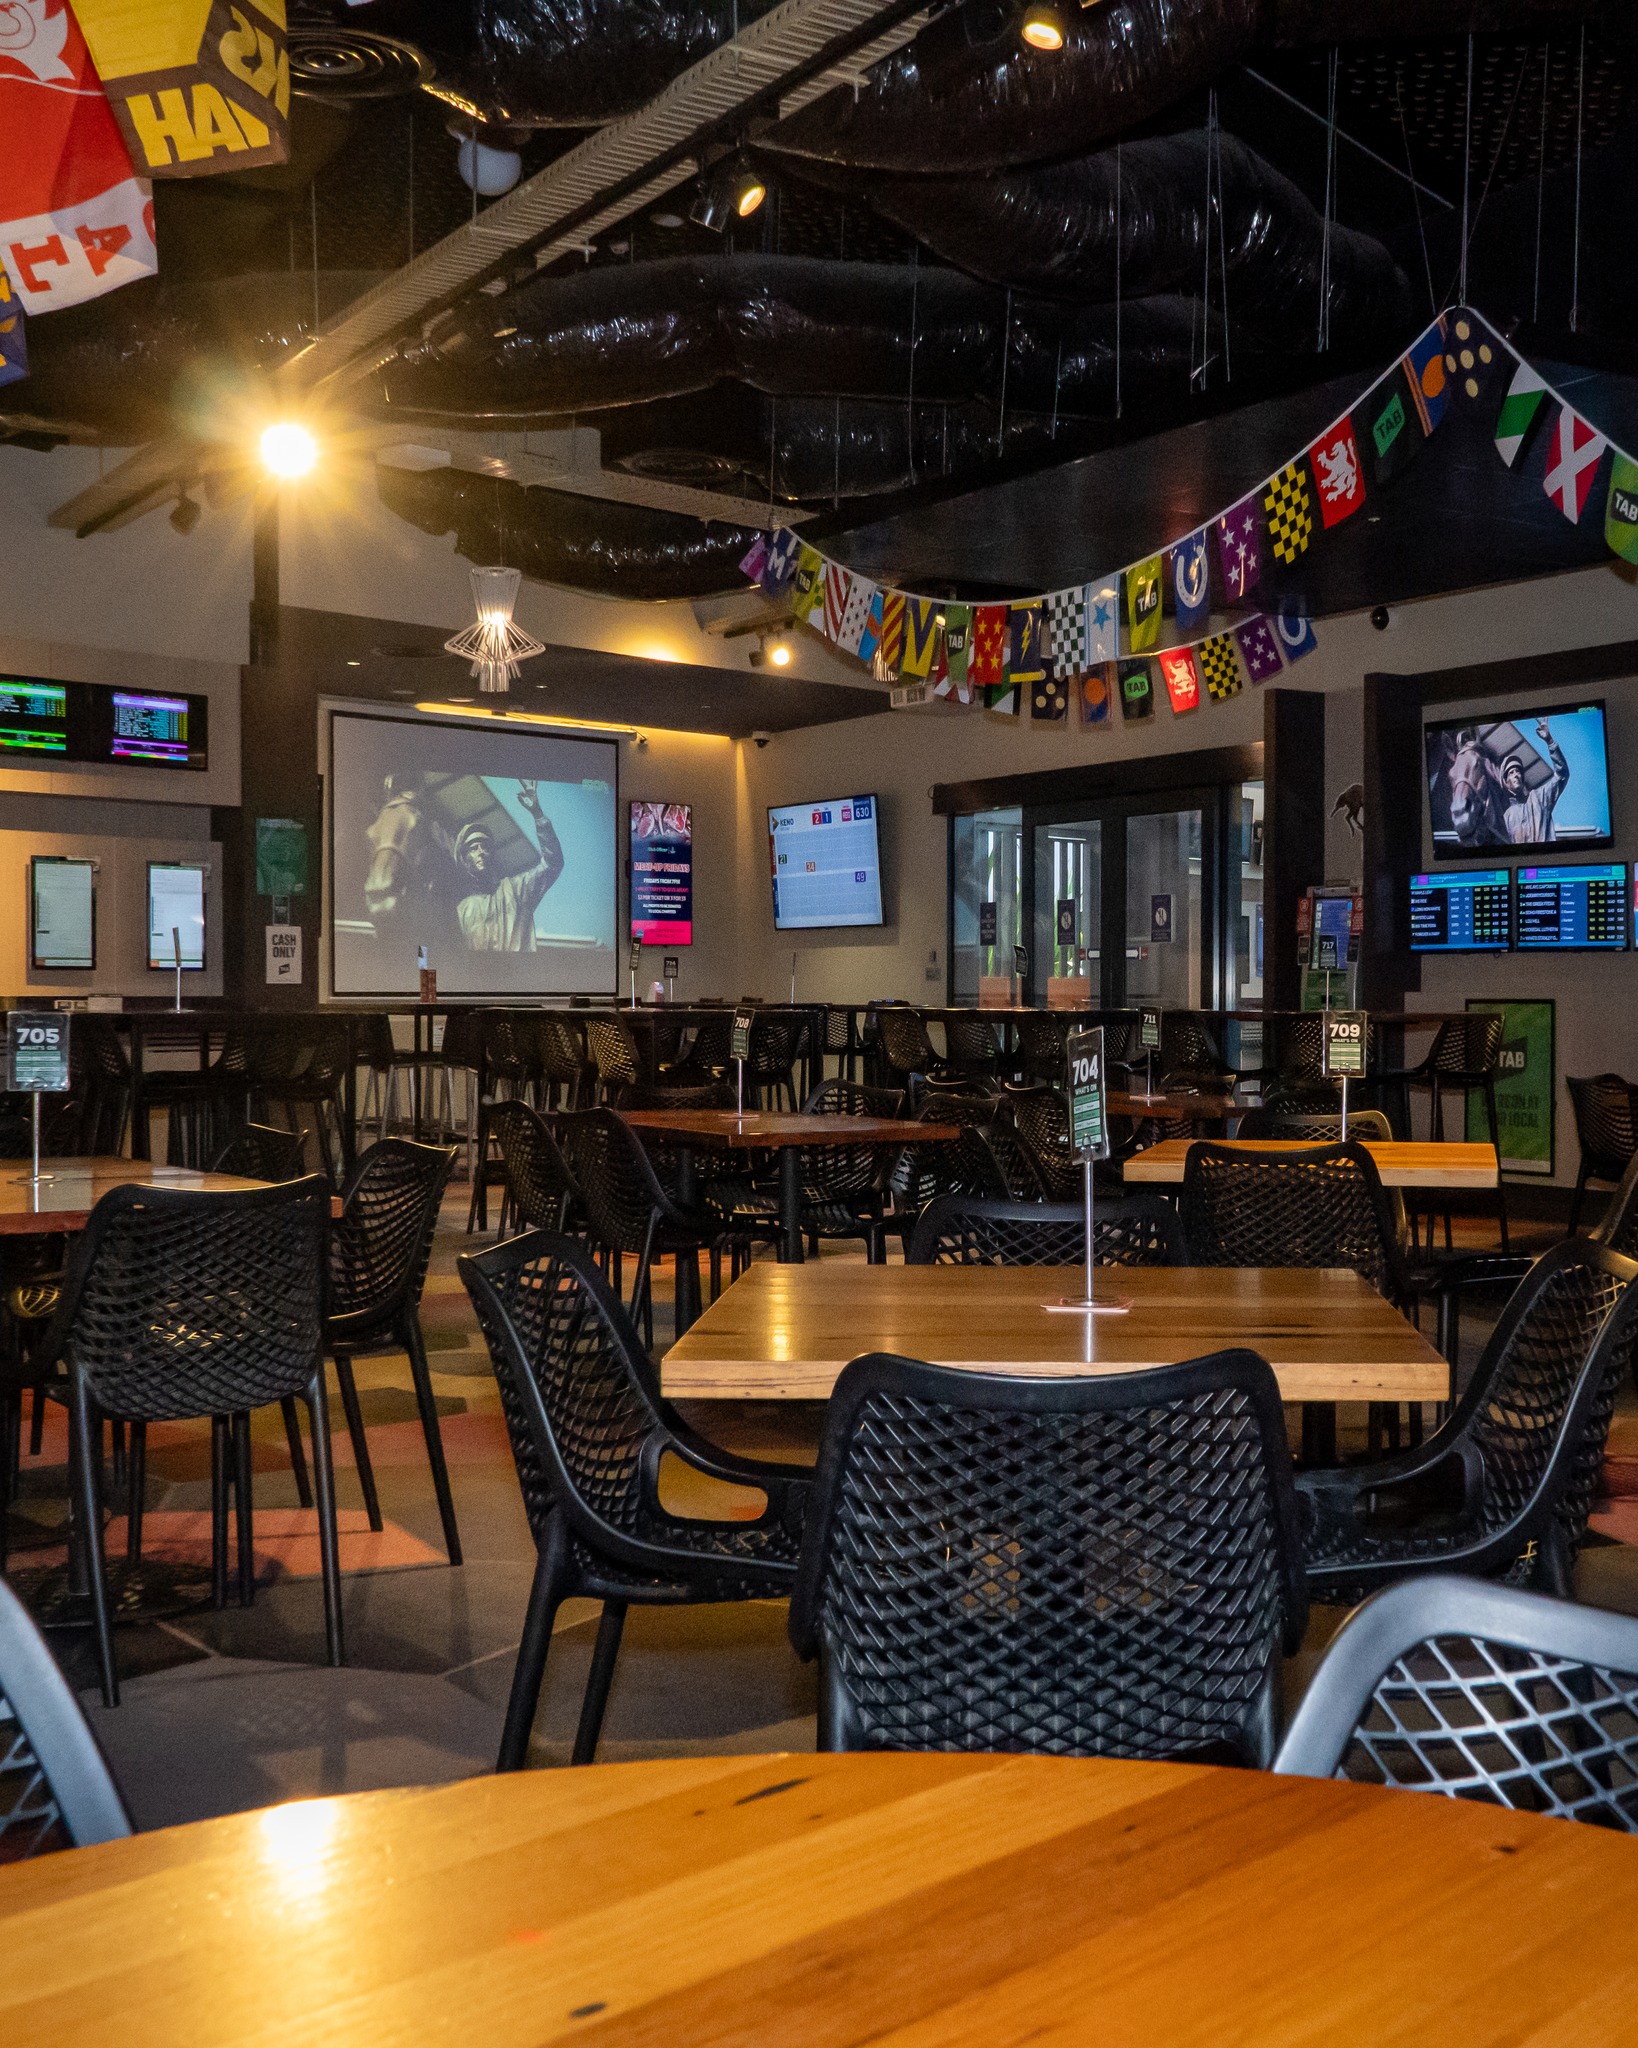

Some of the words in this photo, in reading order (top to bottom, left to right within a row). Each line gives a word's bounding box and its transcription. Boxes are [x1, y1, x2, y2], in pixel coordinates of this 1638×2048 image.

[1376, 411, 1402, 438] TAB
[1616, 492, 1638, 521] TAB
[799, 572, 811, 592] TAB
[1137, 591, 1157, 612] TAB
[948, 634, 963, 648] TAB
[1126, 681, 1146, 693] TAB
[855, 806, 869, 818] 630
[856, 872, 865, 881] 49
[272, 934, 296, 946] CASH
[1322, 941, 1334, 949] 717
[272, 946, 296, 958] ONLY
[735, 1016, 750, 1029] 708
[1143, 1013, 1156, 1024] 711
[16, 1027, 60, 1044] 705
[1329, 1023, 1360, 1038] 709
[1500, 1051, 1525, 1068] TAB
[1072, 1054, 1099, 1086] 704
[1074, 1085, 1090, 1097] WHAT'S
[1090, 1083, 1098, 1092] ON
